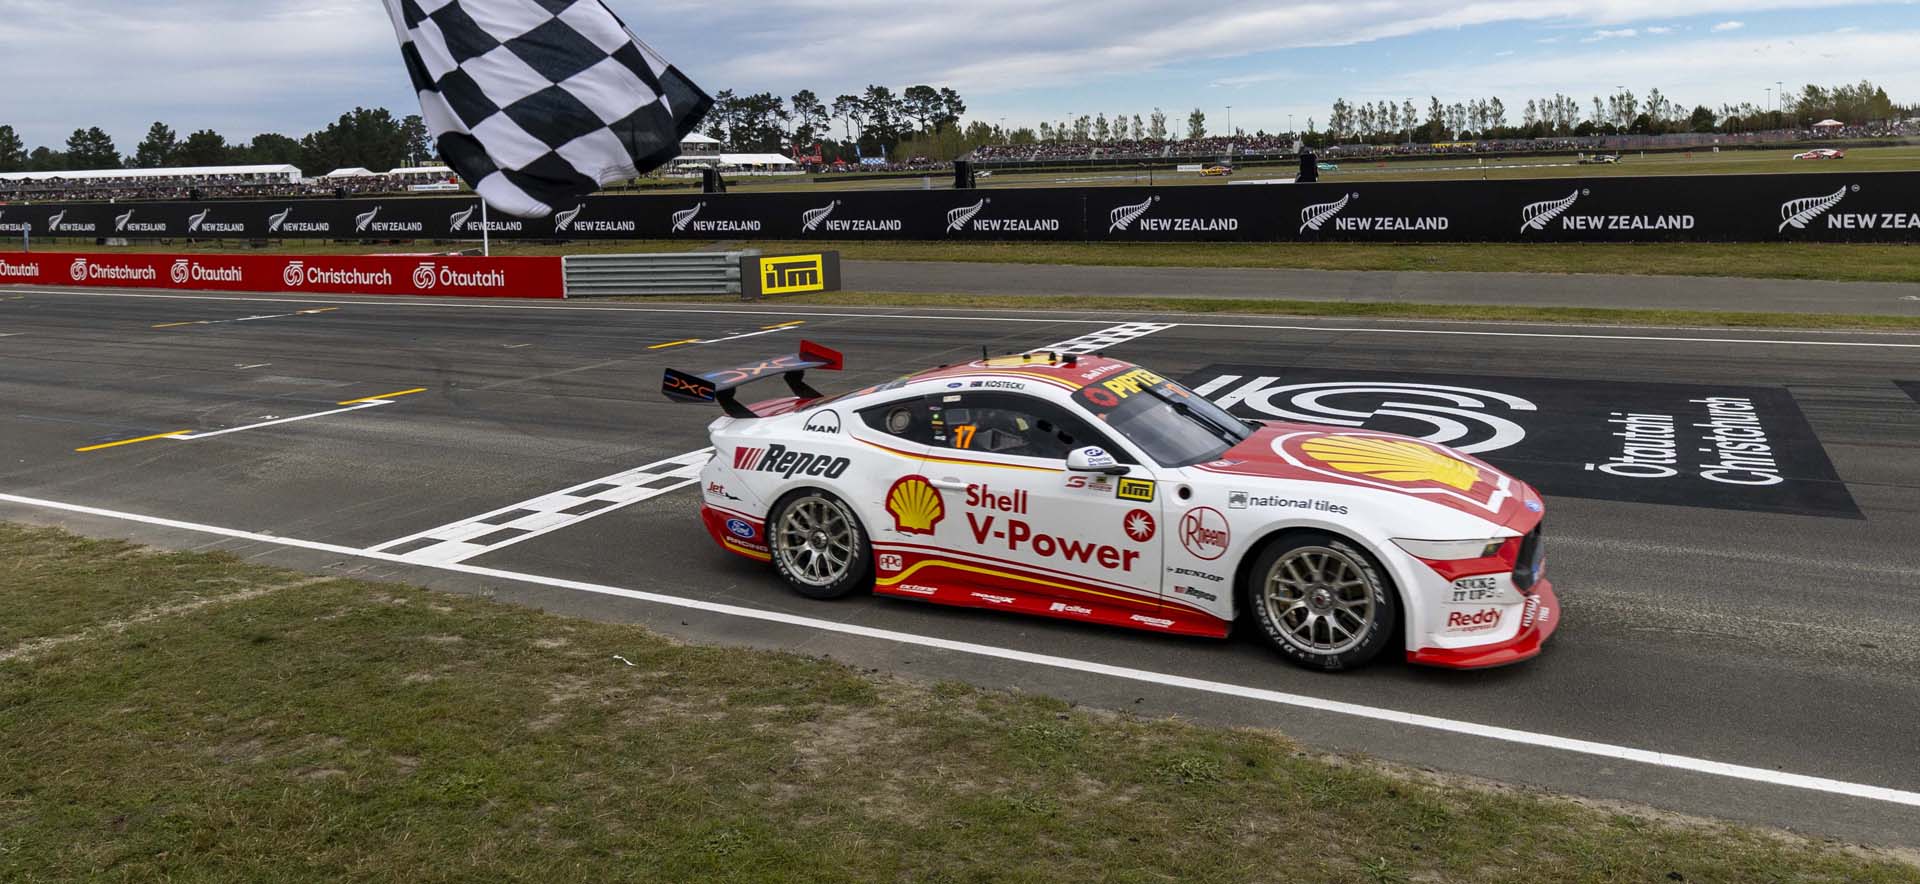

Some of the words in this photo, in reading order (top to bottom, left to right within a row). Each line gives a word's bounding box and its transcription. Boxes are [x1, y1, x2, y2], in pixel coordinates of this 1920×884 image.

[10, 223, 32, 231] ZEALAD
[60, 223, 72, 231] NEW
[72, 223, 96, 231] ZEALAND
[127, 223, 140, 232] NEW
[140, 223, 166, 232] ZEALAND
[202, 223, 216, 232] NEW
[216, 223, 245, 232] ZEALAND
[283, 222, 299, 231] NEW
[299, 222, 330, 231] ZEALAND
[371, 222, 389, 231] NEW
[389, 222, 423, 231] ZEALAND
[467, 222, 485, 231] NEW
[486, 221, 522, 231] ZEALAND
[574, 221, 594, 231] NEW
[595, 221, 635, 231] ZEALAND
[693, 220, 715, 231] NEW
[717, 220, 761, 231] ZEALAND
[826, 219, 850, 231] NEW
[852, 219, 901, 231] ZEALAND
[973, 219, 1001, 231] NEW
[1003, 219, 1059, 231] ZEALAND
[1140, 218, 1171, 231] NEW
[1174, 218, 1238, 231] ZEALAND
[1336, 217, 1371, 230] NEW
[1375, 217, 1448, 230] ZEALAND
[1563, 215, 1604, 229] NEW
[1608, 215, 1694, 229] ZEALAND
[1828, 213, 1877, 229] NEW
[89, 264, 156, 280] Christchurch
[192, 263, 243, 281] Ōtautahi
[307, 267, 392, 285] Christchurch
[440, 266, 505, 287] Ōtautahi
[663, 374, 714, 399] DXC
[985, 381, 1025, 390] KOSTECKI
[806, 424, 837, 434] MAN
[954, 425, 977, 448] 17
[1689, 397, 1784, 486] Christchurch
[757, 443, 850, 479] Repco
[706, 481, 725, 495] Jet
[965, 483, 1028, 515] Shell
[1249, 495, 1312, 510] national
[1315, 500, 1349, 515] tiles
[1185, 508, 1227, 550] Rheem
[726, 535, 769, 552] RACING
[965, 511, 1140, 572] V-Power
[1175, 567, 1225, 582] DUNLOP
[1453, 591, 1467, 601] IT
[1468, 590, 1487, 600] UP
[1447, 607, 1503, 629] Reddy
